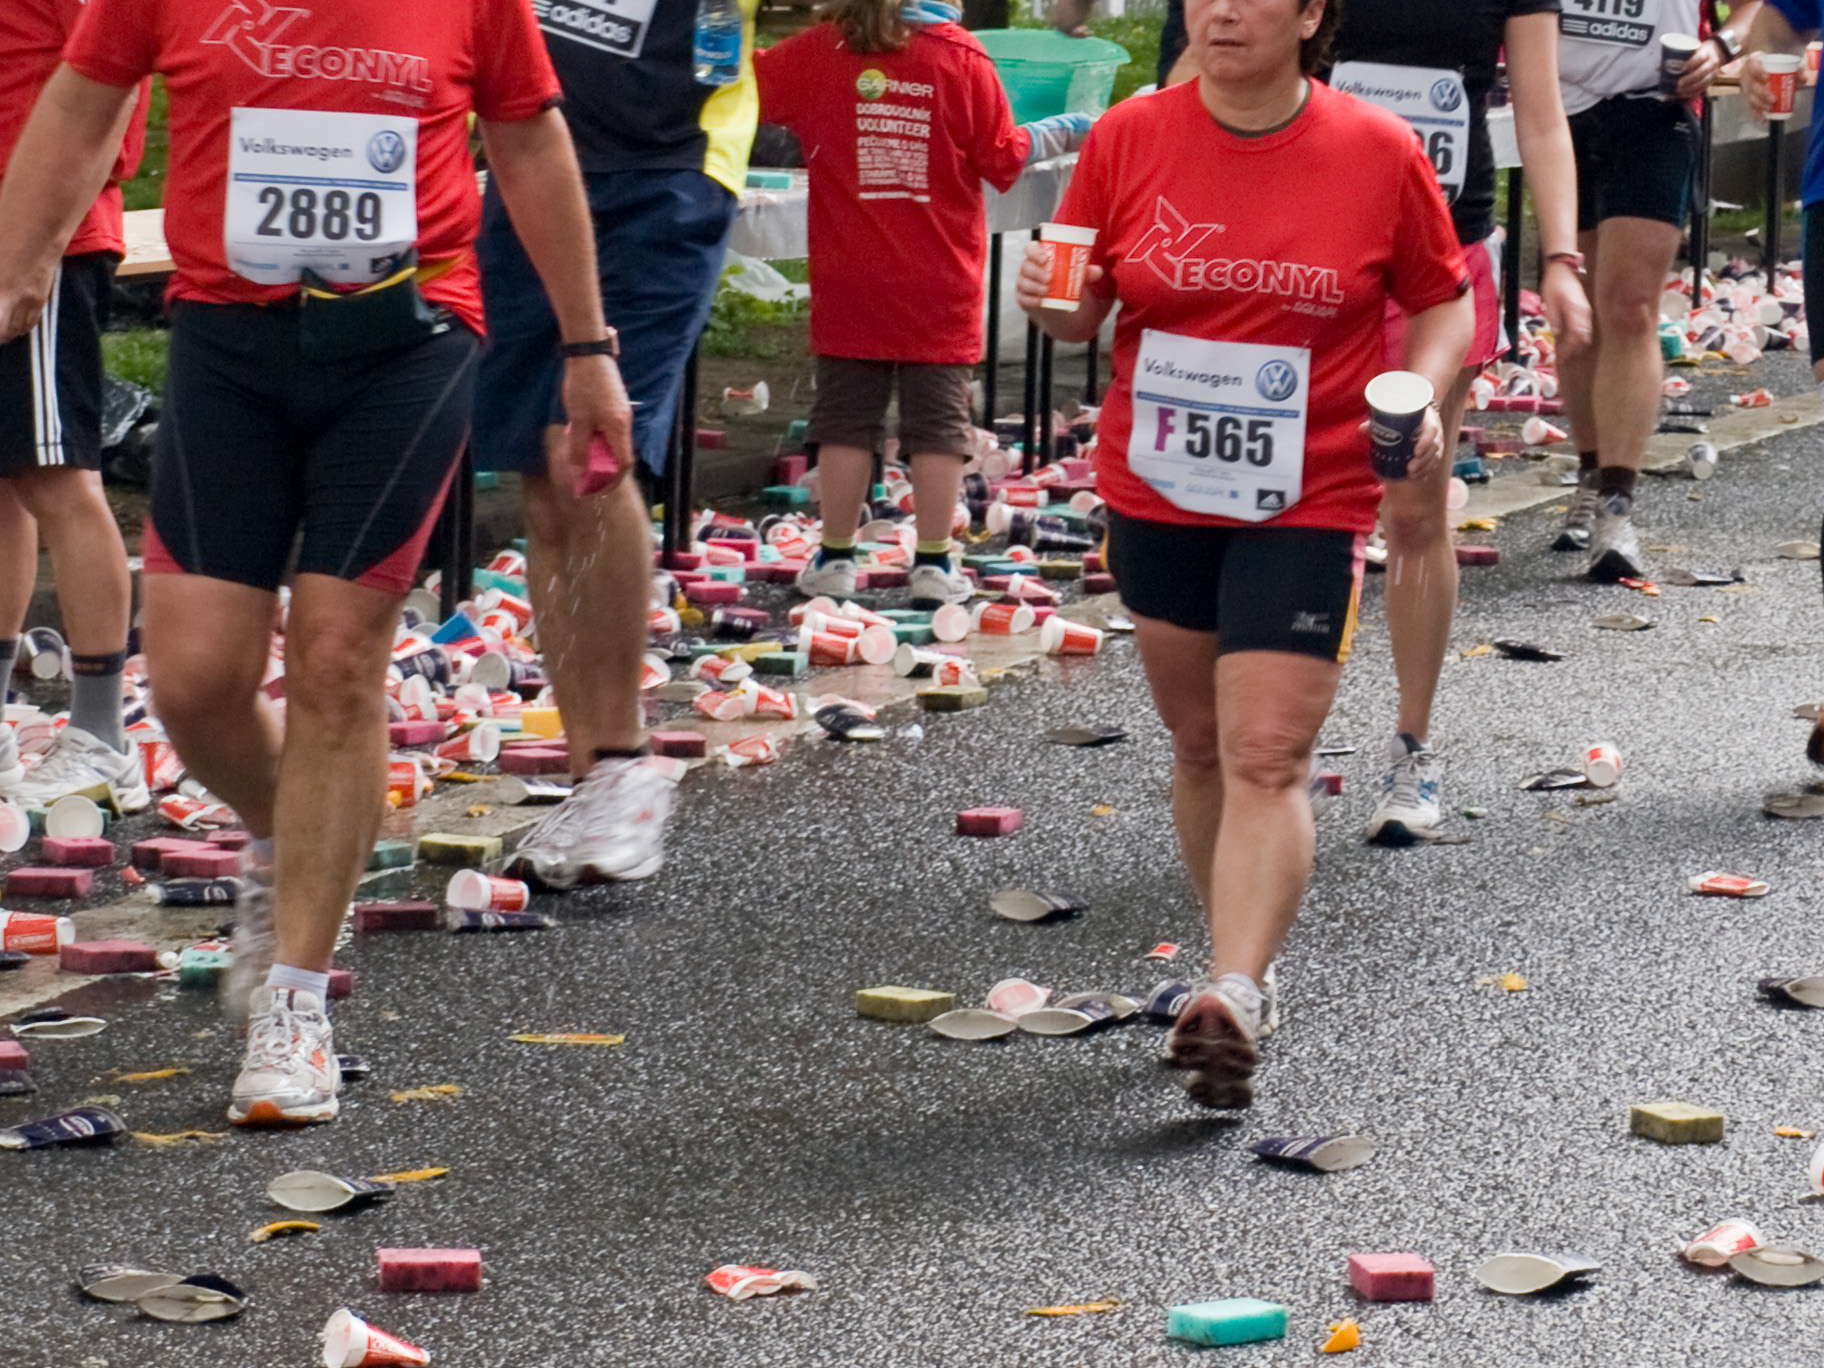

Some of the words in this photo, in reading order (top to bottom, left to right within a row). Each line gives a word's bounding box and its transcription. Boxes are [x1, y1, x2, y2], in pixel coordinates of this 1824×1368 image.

[551, 4, 632, 43] adidas
[1589, 22, 1648, 41] adidas
[264, 44, 433, 93] ECONYL
[857, 77, 934, 98] GARNIER
[1337, 79, 1422, 100] Volkswagen
[857, 118, 931, 138] VOLUNTEER
[239, 138, 353, 161] Volkswagen
[256, 186, 381, 240] 2889
[1176, 258, 1345, 304] ECONYL
[1144, 358, 1243, 388] Volkswagen
[1154, 406, 1177, 451] F
[1185, 412, 1274, 467] 565
